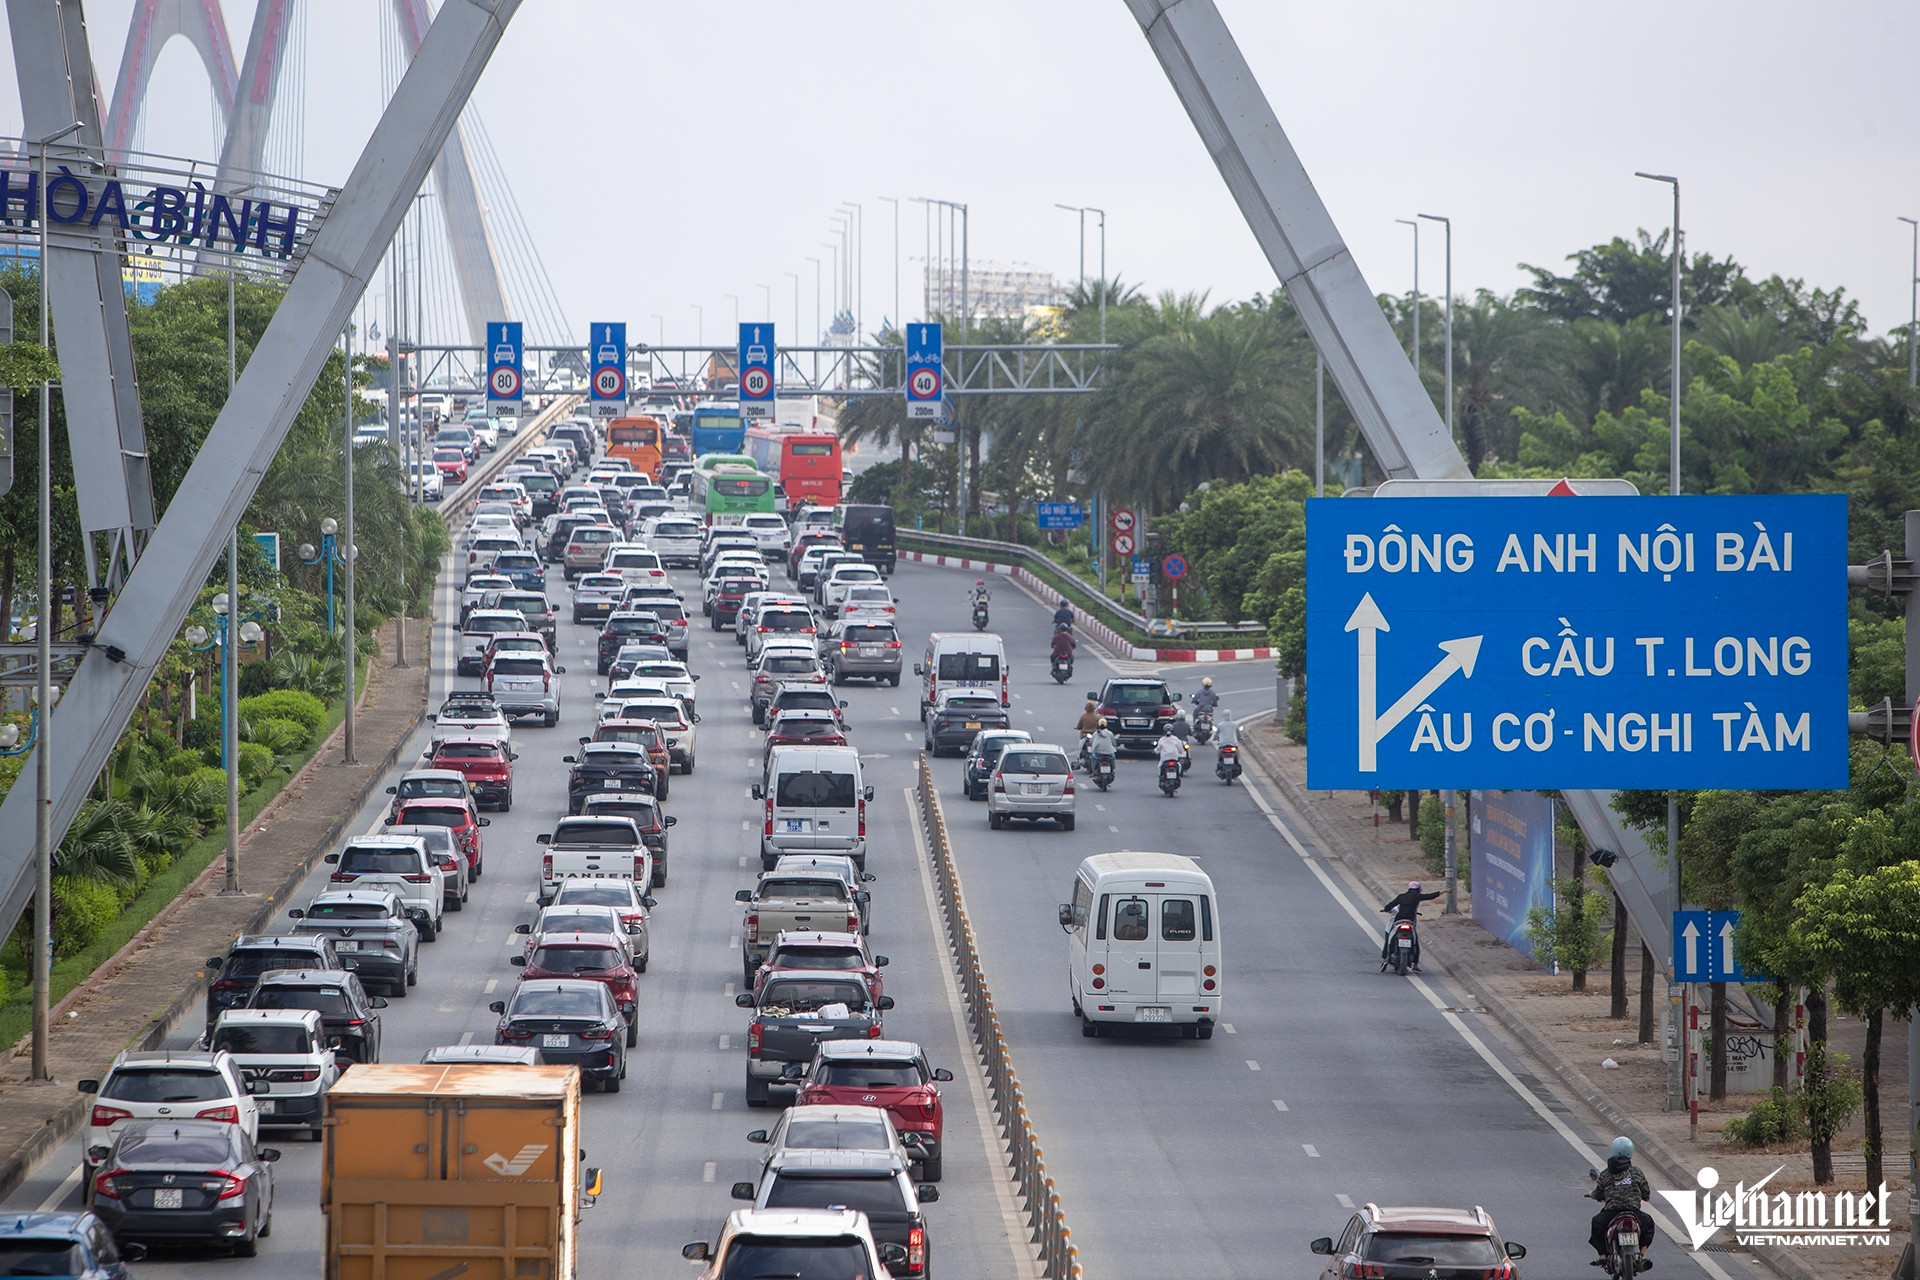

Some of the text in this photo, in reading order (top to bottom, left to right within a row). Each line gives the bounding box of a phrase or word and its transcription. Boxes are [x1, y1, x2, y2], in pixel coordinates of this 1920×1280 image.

[152, 181, 299, 255] BÌNH
[498, 374, 512, 388] 80
[601, 376, 615, 389] 80
[749, 376, 763, 389] 80
[917, 378, 931, 390] 40
[496, 406, 515, 415] 200m
[598, 406, 618, 415] 200m
[747, 407, 765, 416] 200m
[915, 406, 934, 416] 200m
[1344, 521, 1793, 582] ĐÔNG ANH NỘI BÀI
[1521, 617, 1812, 677] CẦU T.LONG
[1409, 703, 1473, 752] ÂU
[1584, 712, 1692, 752] NGHI
[1712, 702, 1811, 752] TÀM
